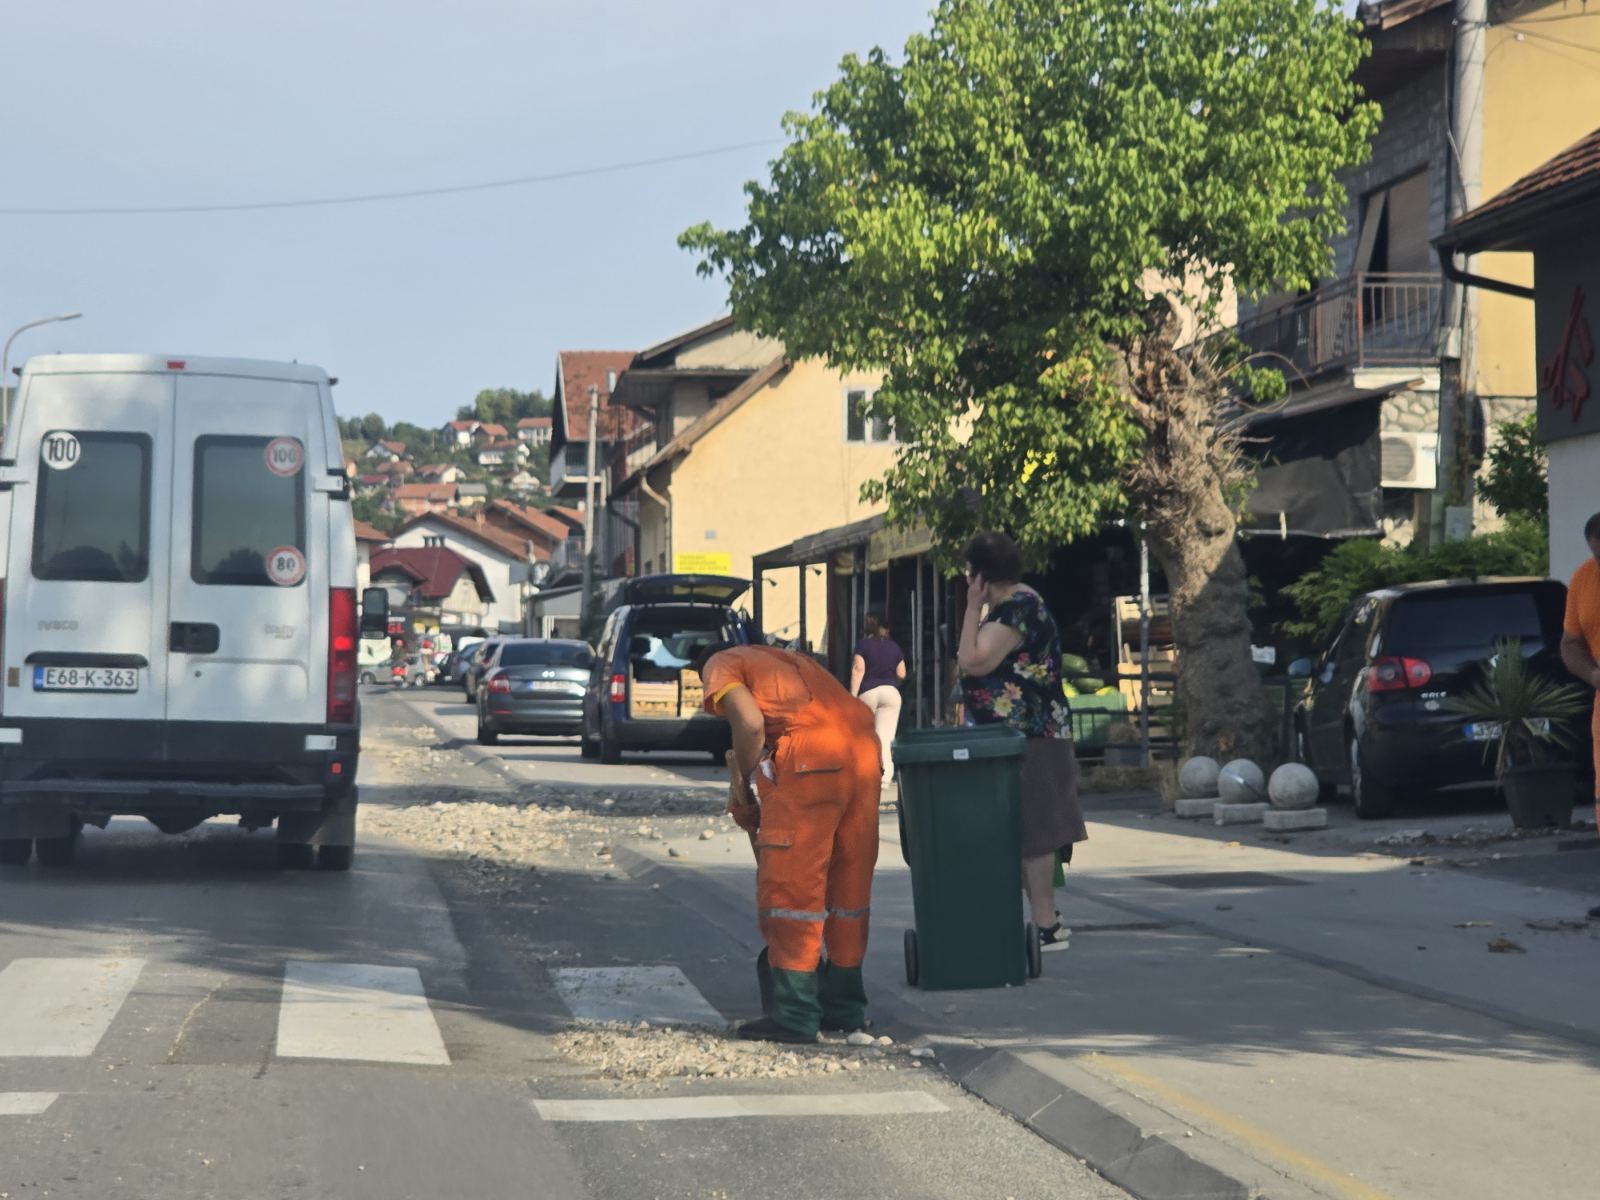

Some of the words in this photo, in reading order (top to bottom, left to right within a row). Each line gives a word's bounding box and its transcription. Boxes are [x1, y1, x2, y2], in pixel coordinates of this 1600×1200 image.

[47, 437, 77, 462] 100
[272, 447, 297, 464] 100
[277, 556, 295, 572] 80
[46, 669, 135, 687] E68-K-363
